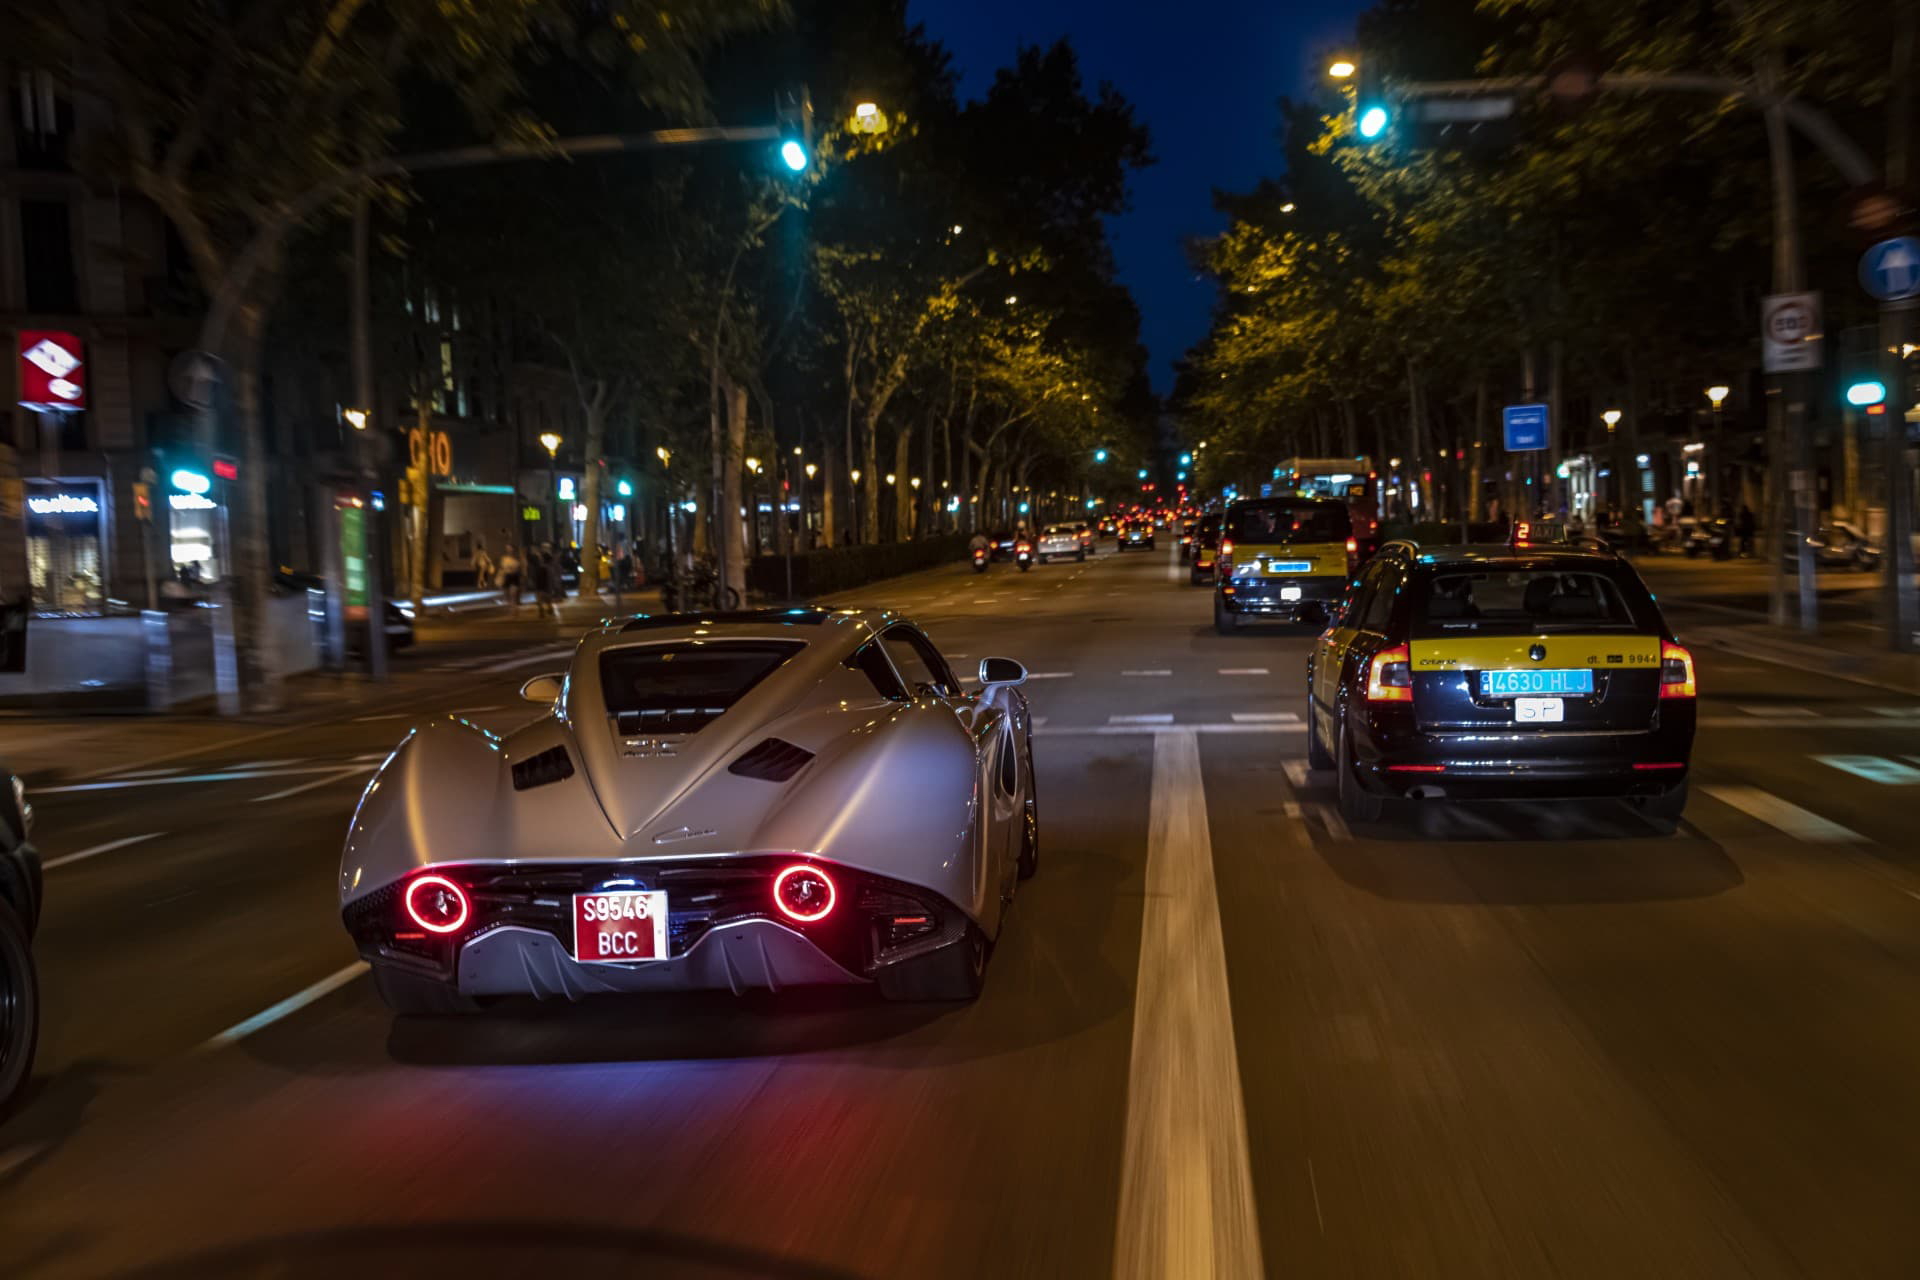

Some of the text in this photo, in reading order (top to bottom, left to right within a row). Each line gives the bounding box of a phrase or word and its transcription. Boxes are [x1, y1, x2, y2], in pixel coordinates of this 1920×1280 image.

[1628, 654, 1657, 664] 9944
[1495, 672, 1587, 691] 4630 HLJ
[583, 896, 650, 922] S9546
[598, 931, 639, 956] BCC
